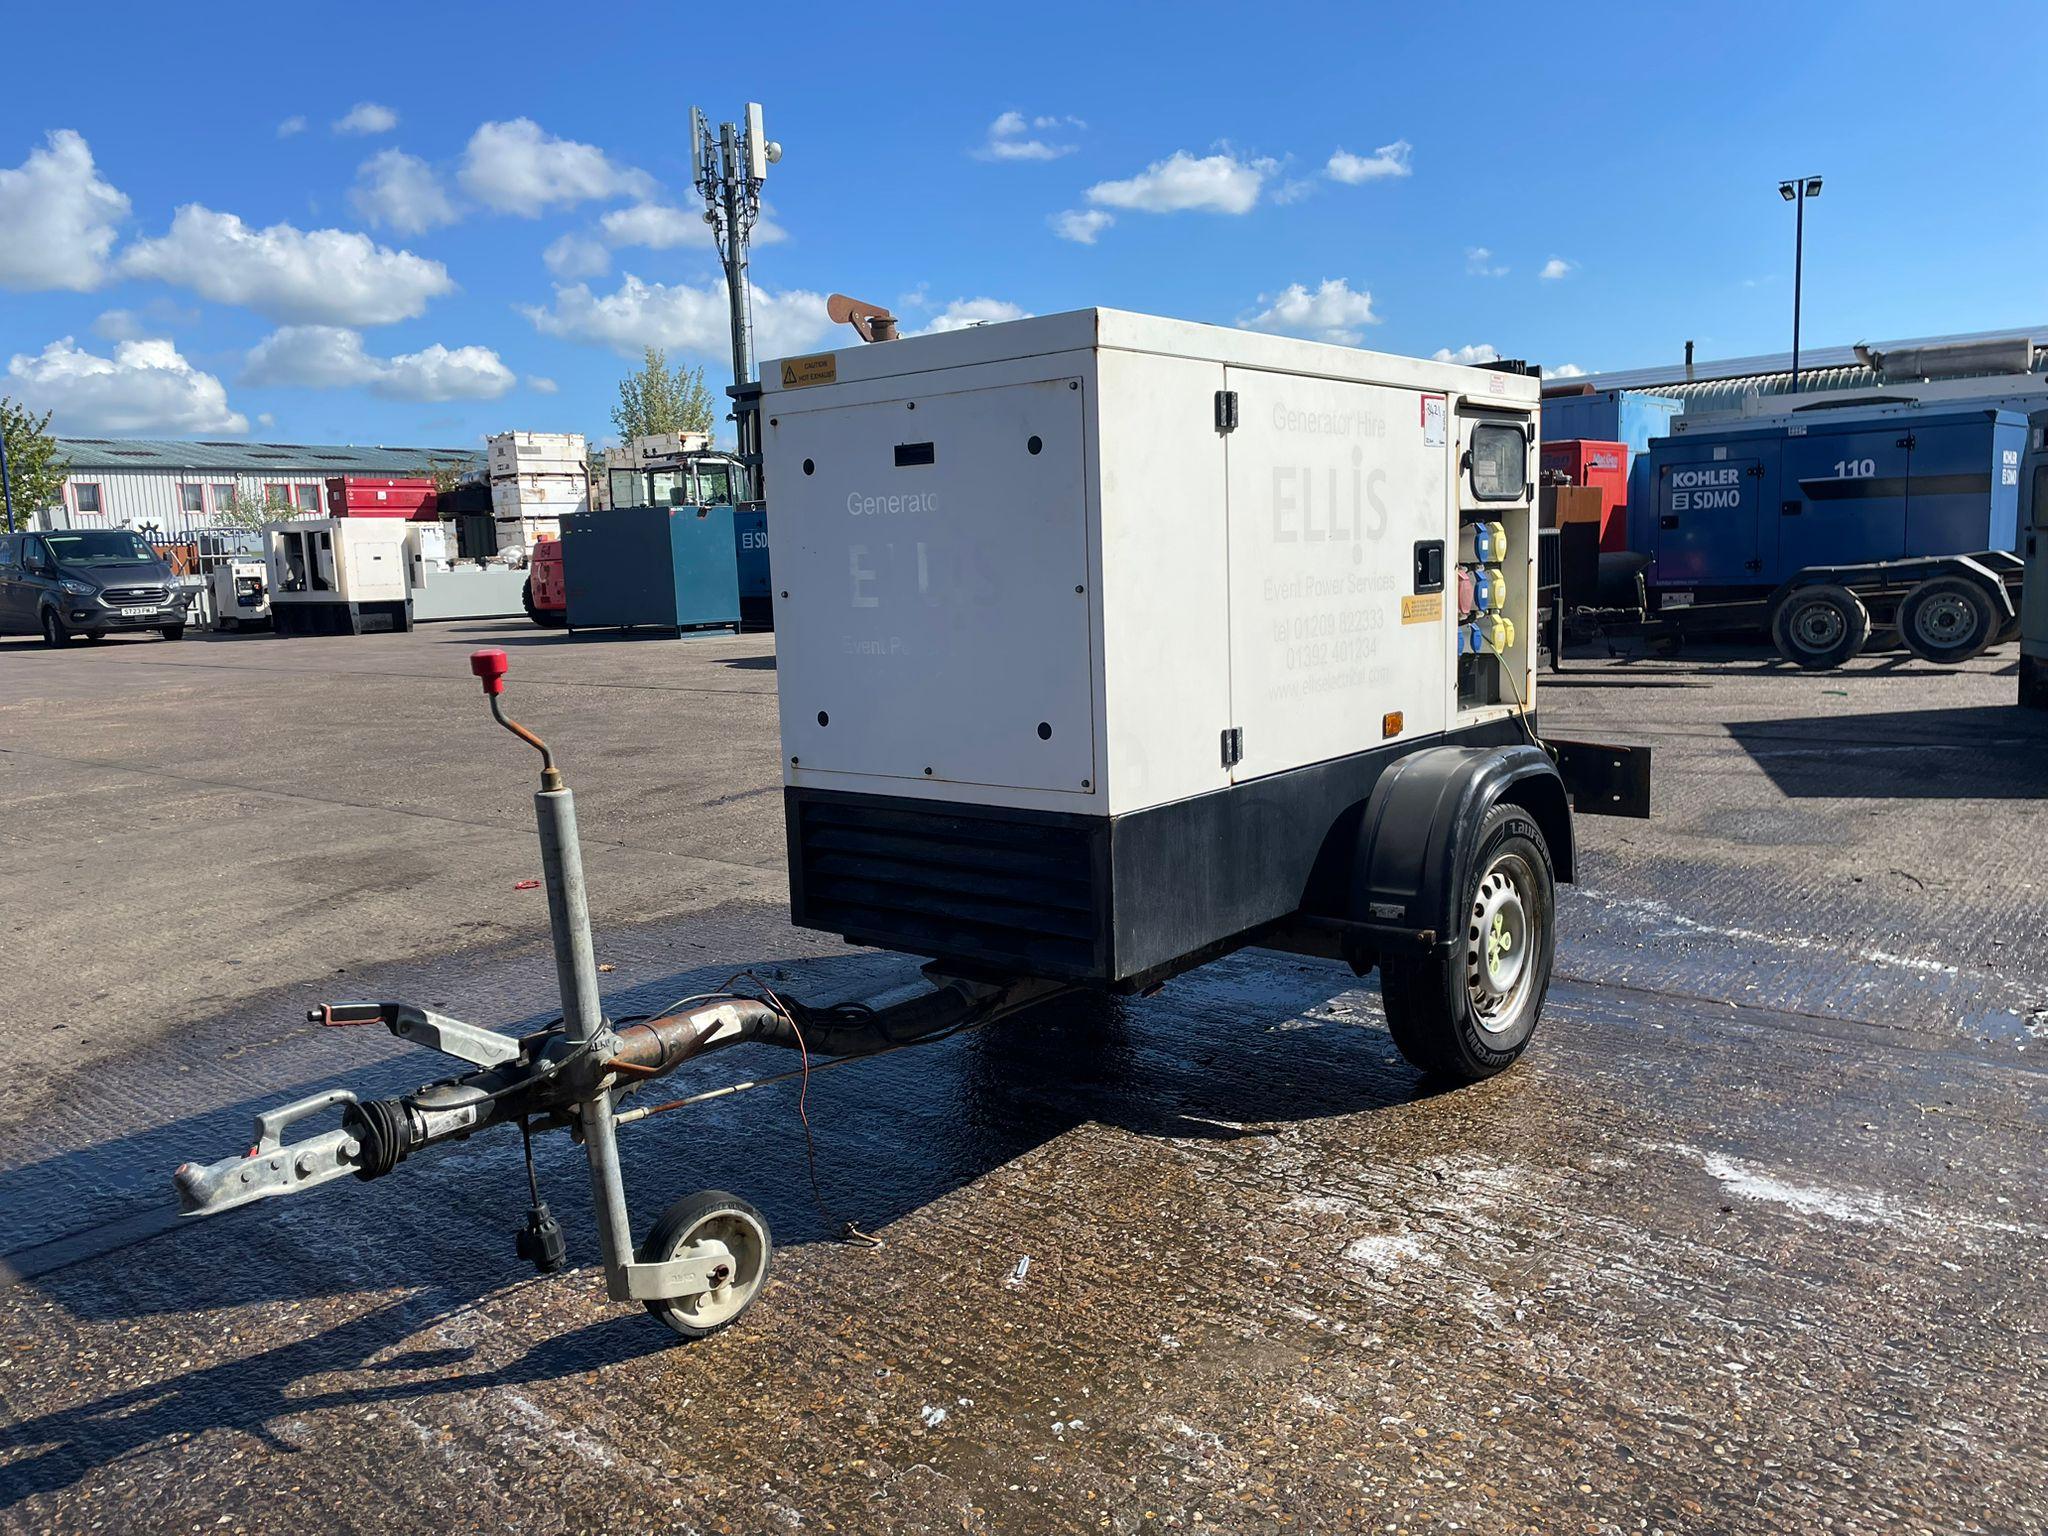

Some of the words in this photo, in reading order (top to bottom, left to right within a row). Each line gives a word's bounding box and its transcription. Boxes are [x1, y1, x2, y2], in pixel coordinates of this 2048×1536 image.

[1272, 401, 1353, 436] Generator
[1357, 410, 1387, 439] Hire
[1672, 468, 1740, 488] KOHLER
[1834, 458, 1876, 478] 110
[1693, 489, 1740, 510] SDMO
[755, 532, 769, 549] SD
[1263, 577, 1302, 601] Event
[1305, 574, 1344, 597] Power
[1347, 572, 1397, 594] Services
